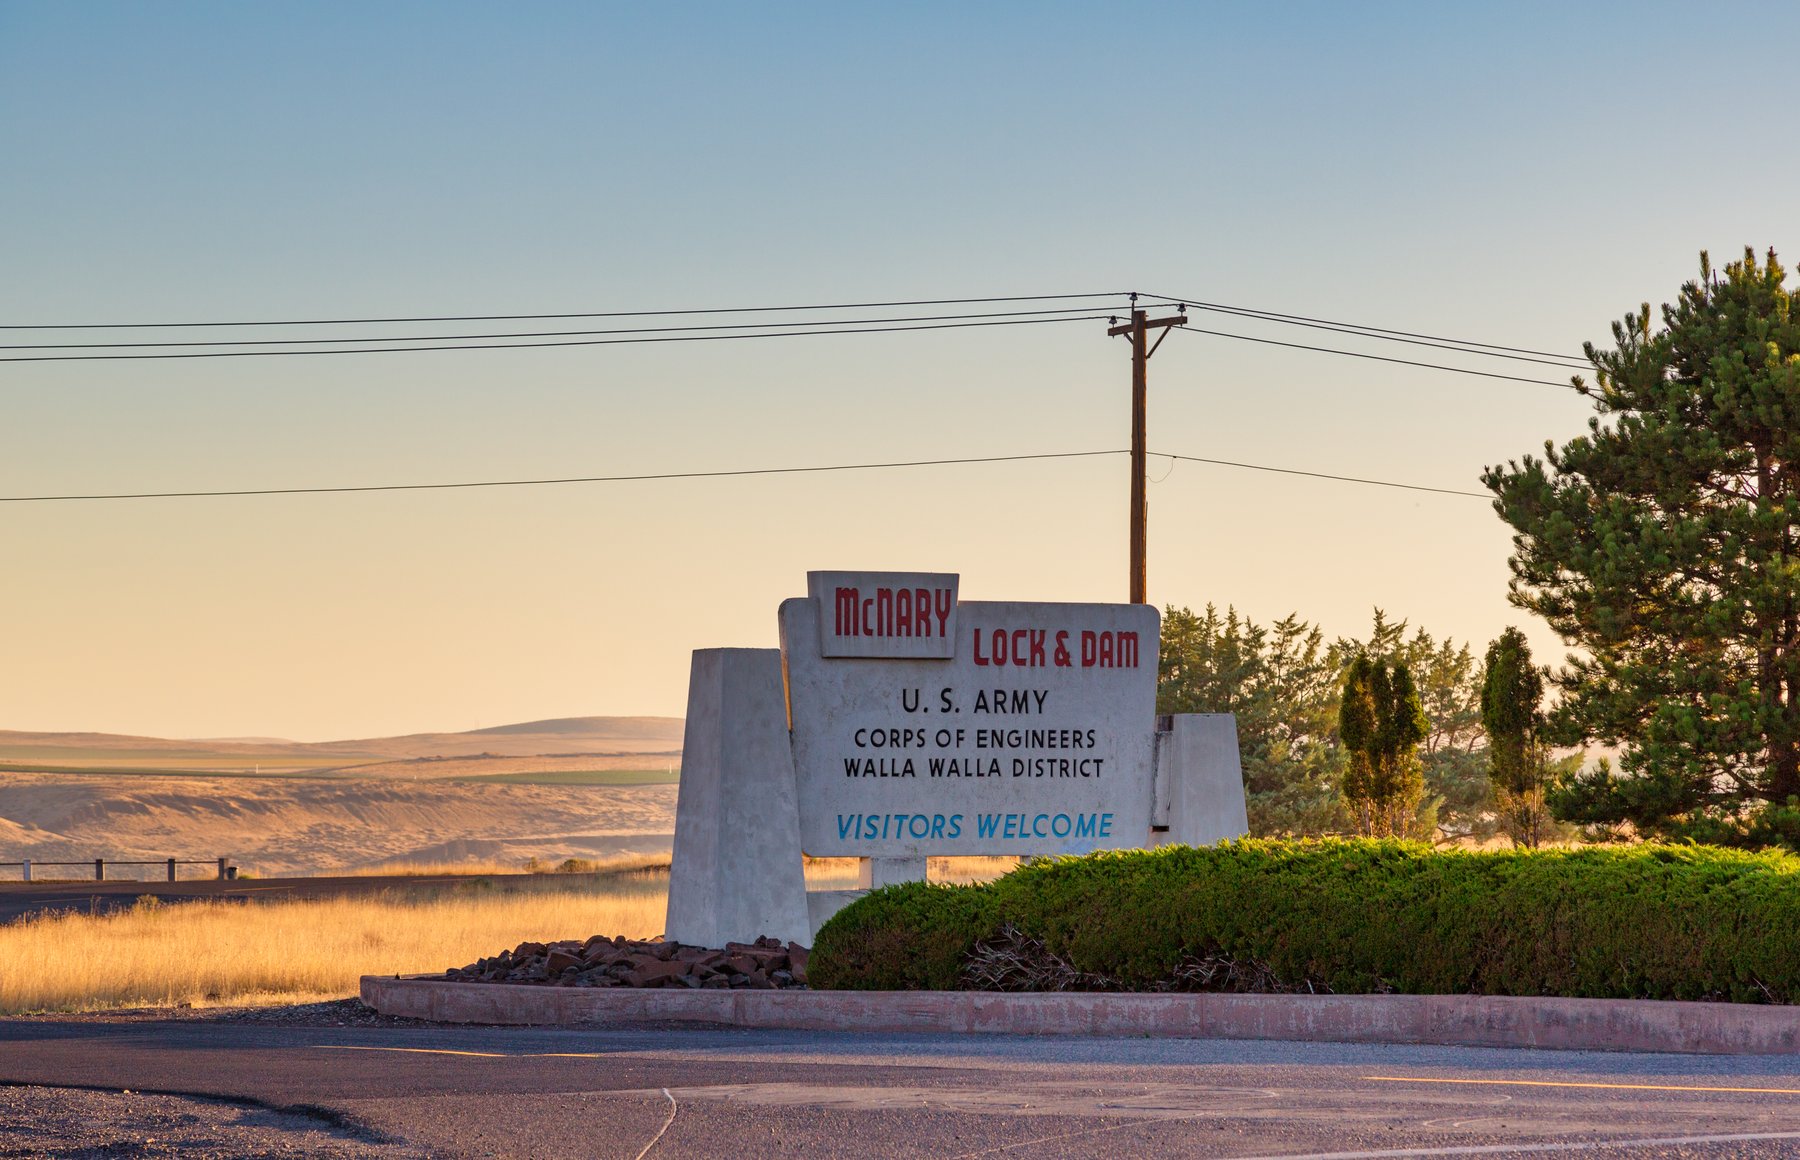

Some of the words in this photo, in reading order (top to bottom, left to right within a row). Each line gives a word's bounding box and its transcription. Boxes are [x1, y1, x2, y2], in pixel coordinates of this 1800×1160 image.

[835, 587, 951, 637] McNARY
[974, 628, 1045, 667] LOCK
[1054, 631, 1072, 667] &
[1081, 630, 1139, 668] DAM
[974, 689, 1048, 714] ARMY
[854, 728, 925, 748] CORPS
[935, 729, 966, 748] OF
[977, 729, 1096, 748] ENGINEERS
[844, 758, 915, 778] WALLA
[929, 758, 1001, 778] WALLA
[1012, 759, 1104, 778] DISTRICT
[837, 814, 963, 840] VISITORS
[977, 813, 1114, 839] WELCOME
